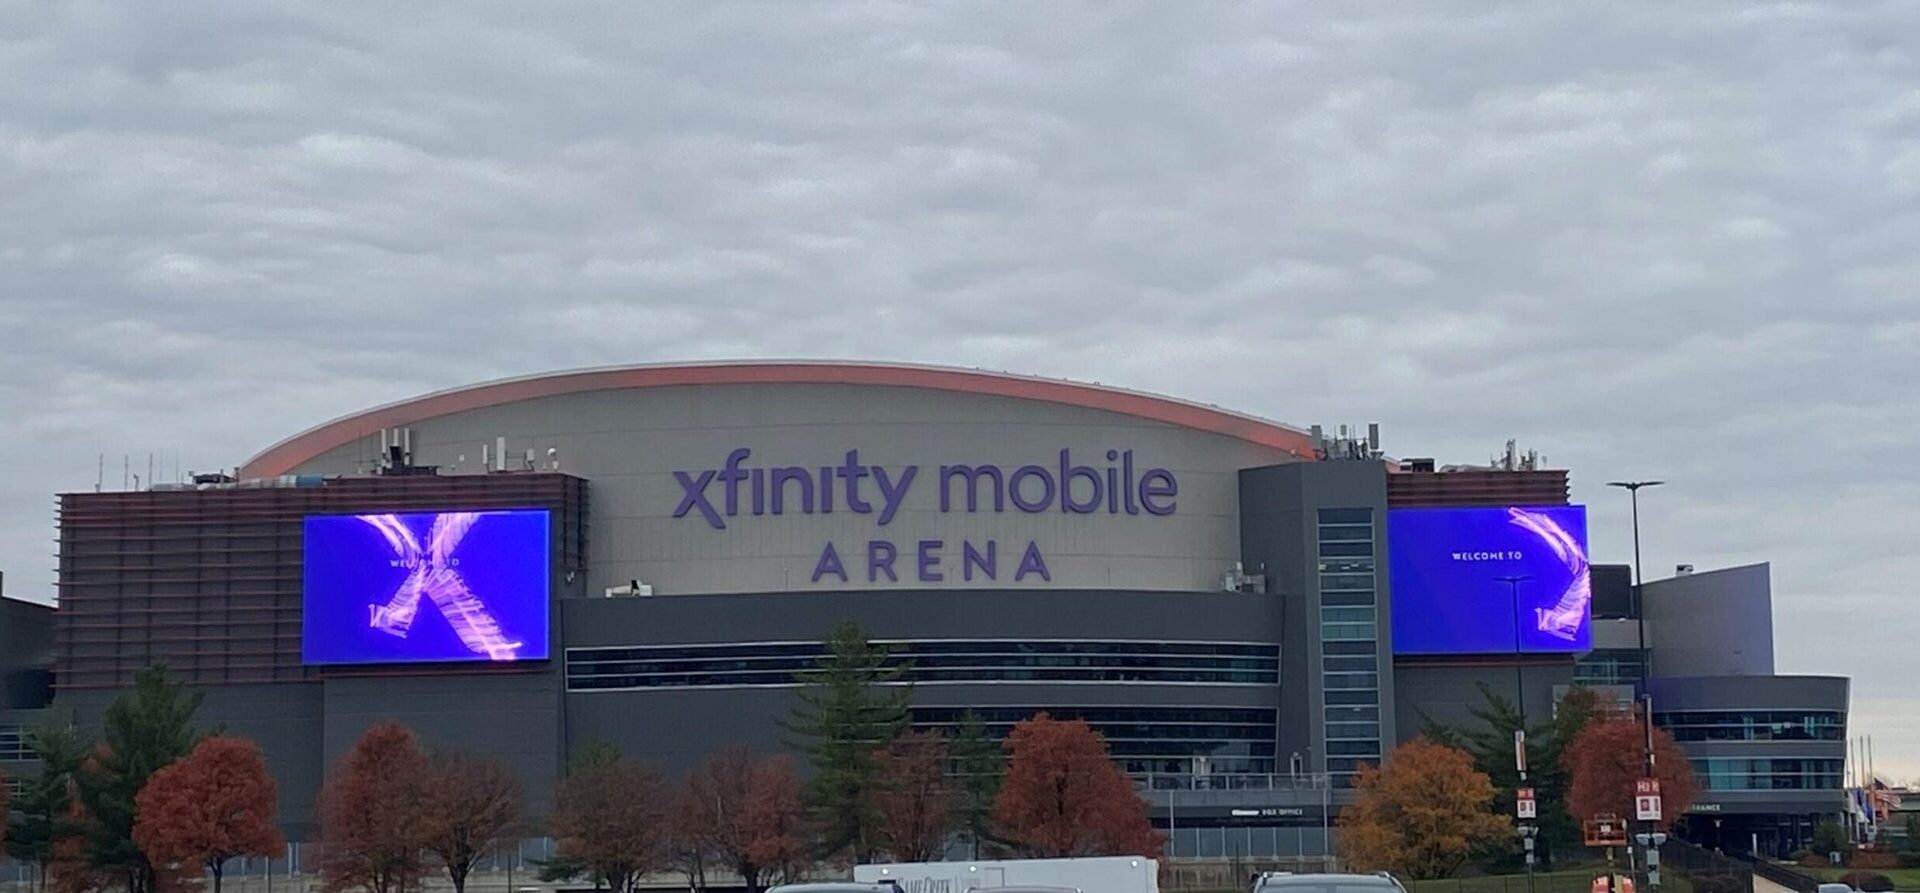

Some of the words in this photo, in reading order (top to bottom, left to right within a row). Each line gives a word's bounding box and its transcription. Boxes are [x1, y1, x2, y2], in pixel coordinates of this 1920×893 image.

[672, 447, 918, 529] xfinity
[940, 447, 1178, 516] mobile
[811, 539, 1052, 584] ARENA
[1452, 551, 1504, 561] WELCOME
[1507, 550, 1523, 560] TO
